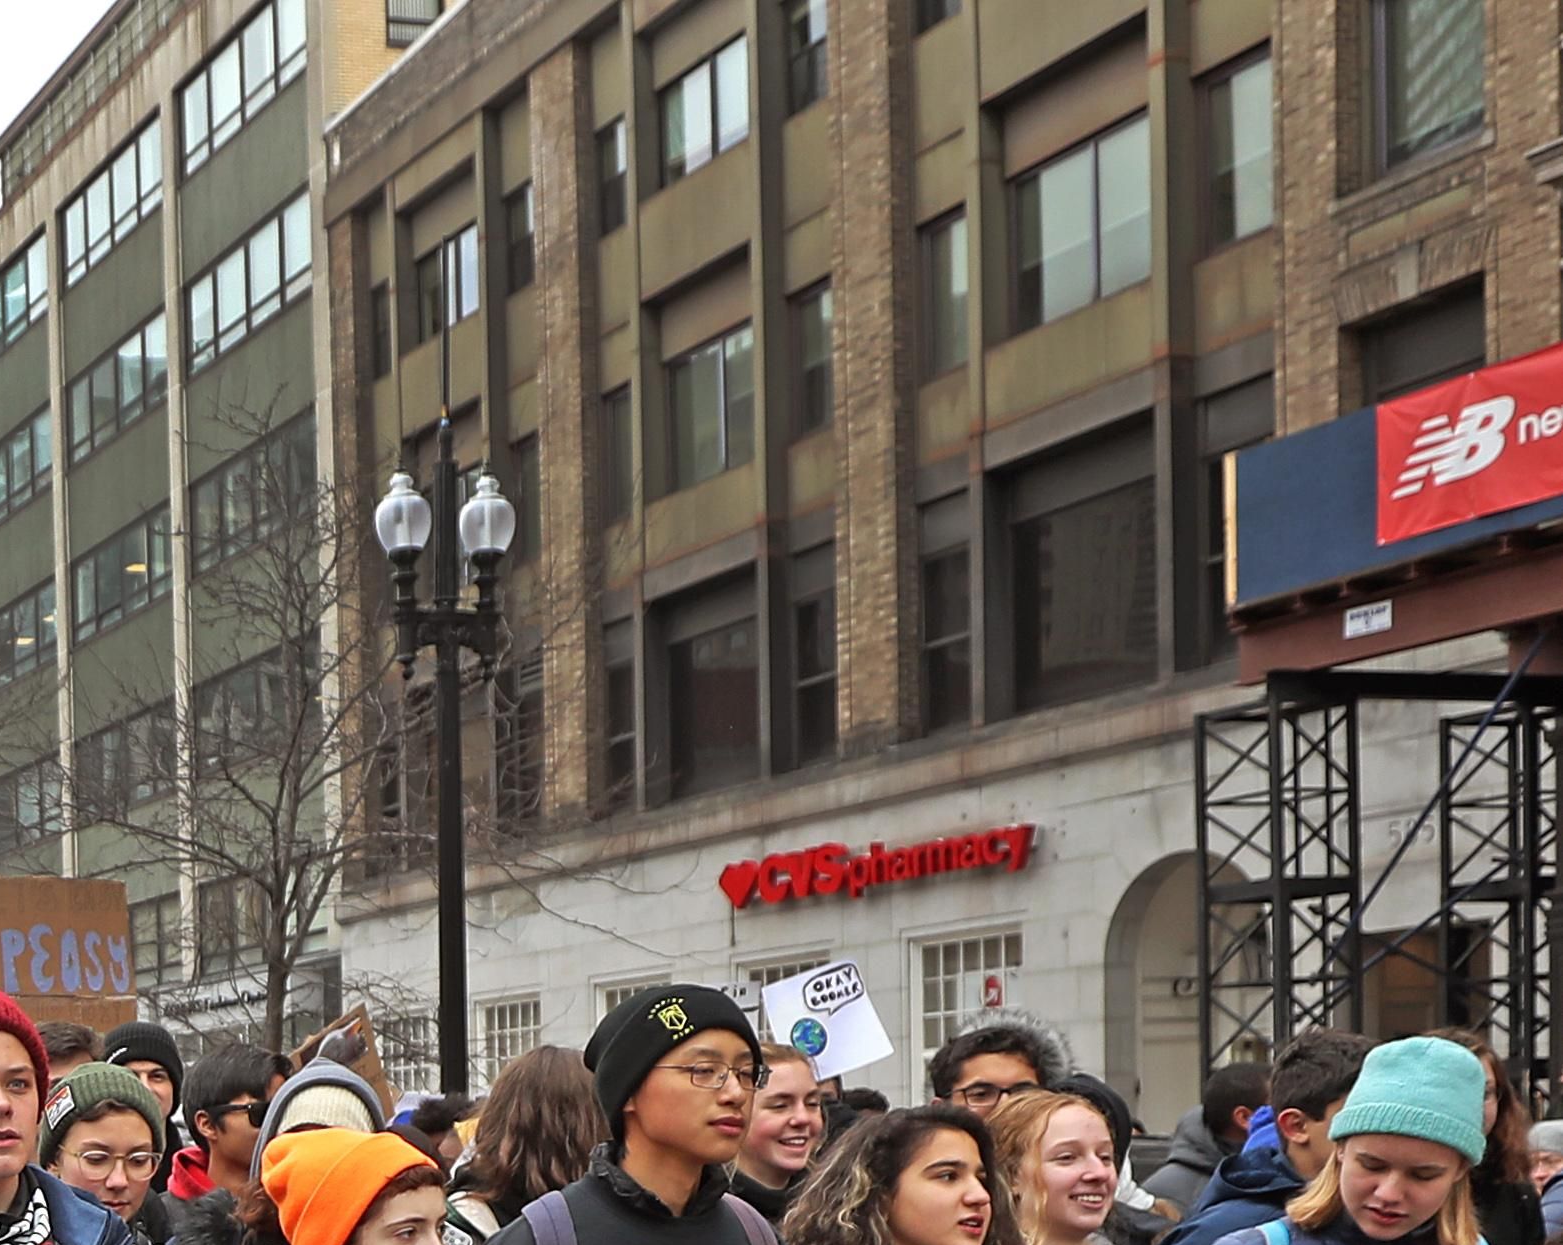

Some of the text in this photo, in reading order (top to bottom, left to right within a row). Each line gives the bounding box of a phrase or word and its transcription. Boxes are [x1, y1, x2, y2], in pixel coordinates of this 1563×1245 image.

[1517, 403, 1563, 444] ne
[756, 823, 1038, 904] CVS pharmacy
[0, 923, 131, 993] PEASY
[813, 966, 854, 993] OKAY
